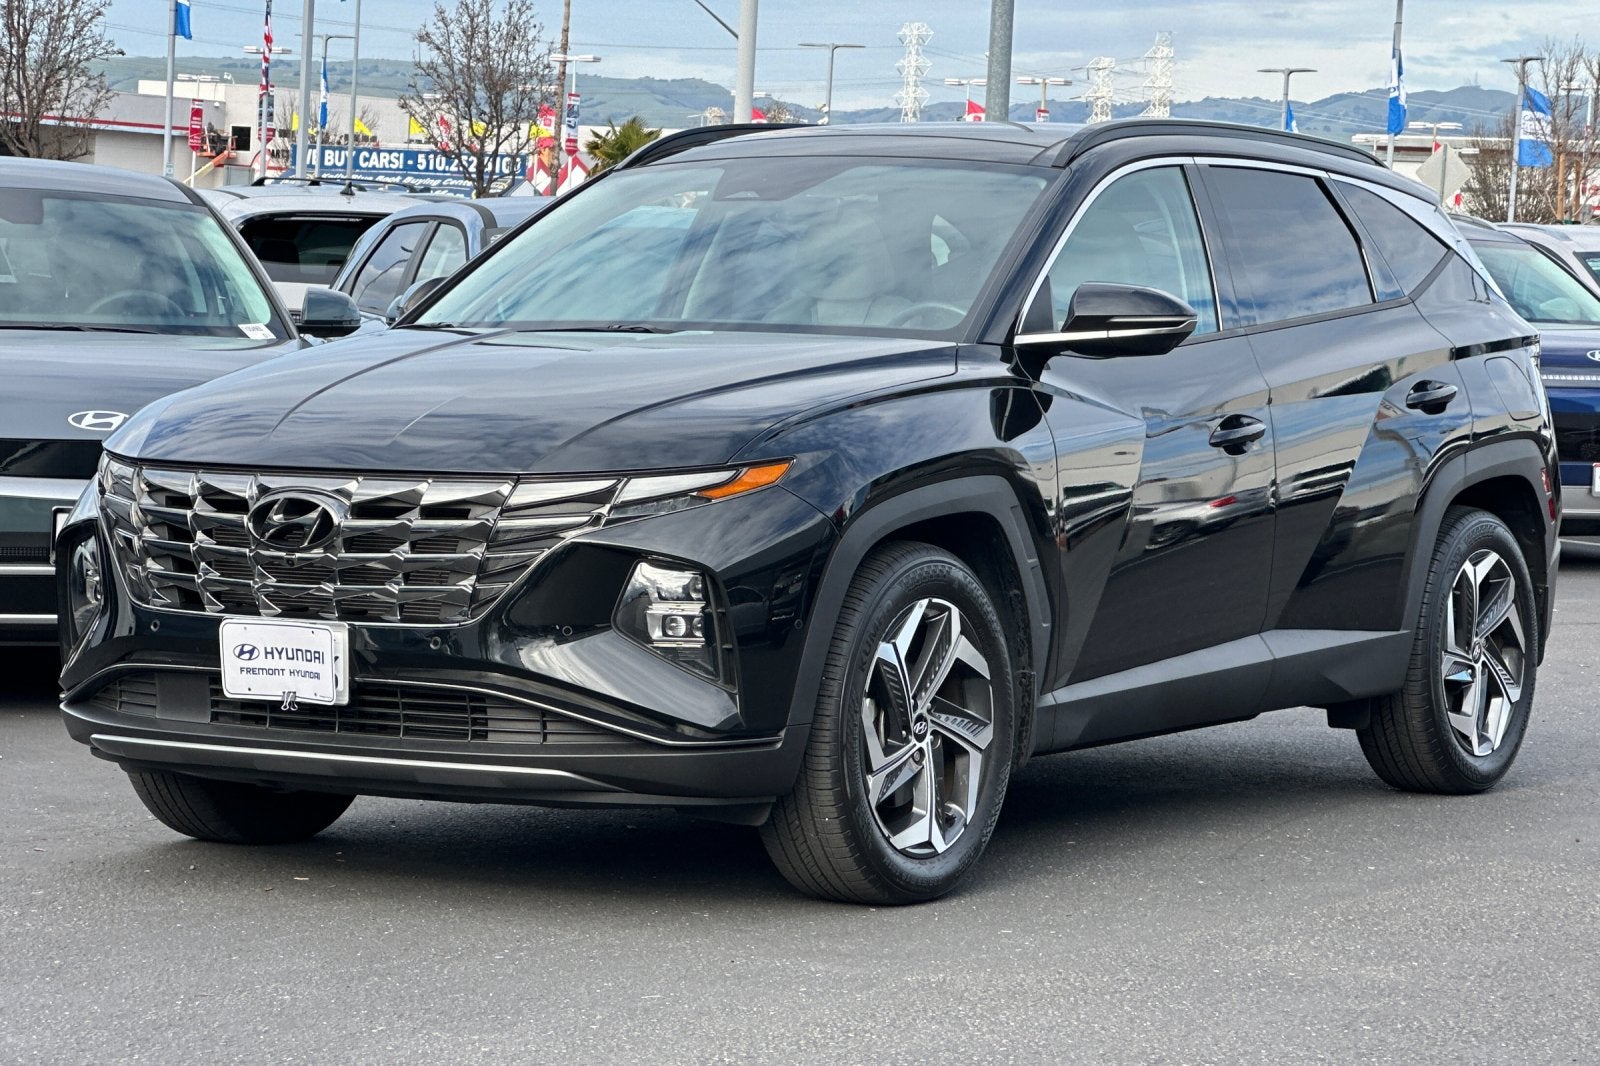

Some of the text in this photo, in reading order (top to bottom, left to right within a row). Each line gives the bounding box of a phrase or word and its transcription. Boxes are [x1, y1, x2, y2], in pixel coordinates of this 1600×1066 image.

[324, 149, 356, 166] BUY
[359, 150, 404, 169] CARS!
[403, 176, 442, 186] Buying
[264, 646, 325, 665] HYUNDAI
[239, 666, 321, 680] FREMONT HYUNDAI
